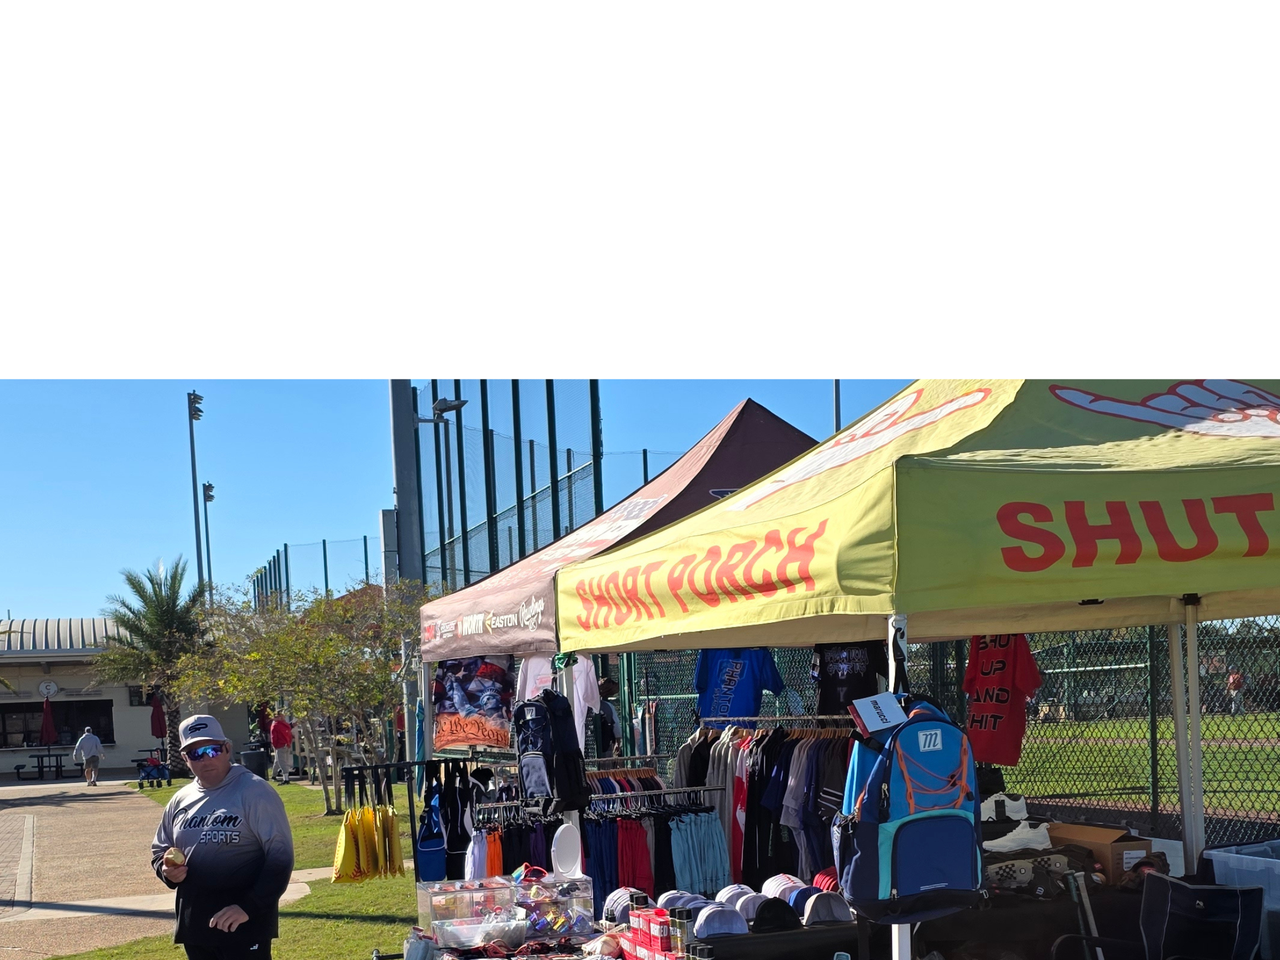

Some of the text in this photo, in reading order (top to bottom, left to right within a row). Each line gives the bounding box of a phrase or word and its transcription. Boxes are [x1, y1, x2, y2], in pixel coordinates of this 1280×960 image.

[995, 492, 1274, 573] SHUT
[575, 518, 829, 631] SHORT PORCH
[491, 613, 518, 628] EASTON
[980, 660, 1007, 676] UP
[972, 687, 1010, 704] AND
[870, 700, 891, 724] marucci
[970, 713, 1004, 731] HIT
[172, 808, 243, 830] Phantom
[199, 830, 241, 845] SPORTS
